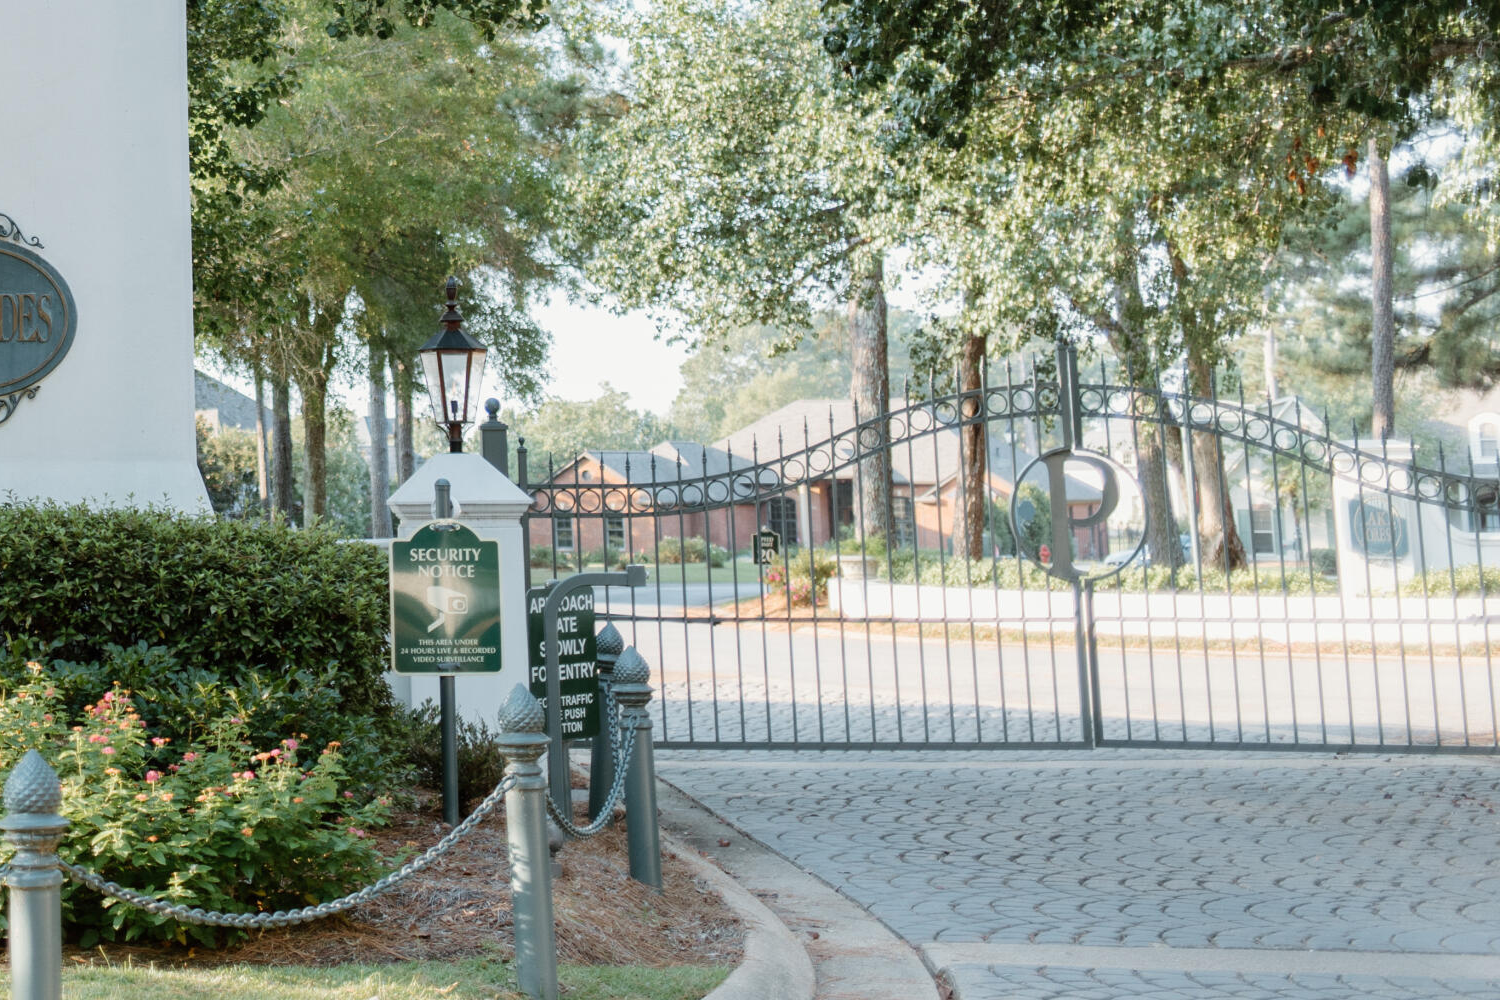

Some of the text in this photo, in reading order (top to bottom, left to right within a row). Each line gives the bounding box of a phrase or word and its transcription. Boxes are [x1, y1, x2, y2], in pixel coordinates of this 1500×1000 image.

[410, 548, 481, 562] SECURITY
[418, 565, 476, 578] NOTICE
[530, 594, 593, 614] APOACH
[556, 616, 578, 633] ATE
[400, 647, 409, 655] 24
[410, 647, 436, 655] HOURS
[437, 647, 452, 655] LIVE
[460, 647, 496, 655] RECORDED
[559, 661, 595, 681] ENTRY
[560, 692, 594, 706] TRAFFIC
[564, 707, 586, 720] PUSH
[561, 720, 583, 733] TTON
